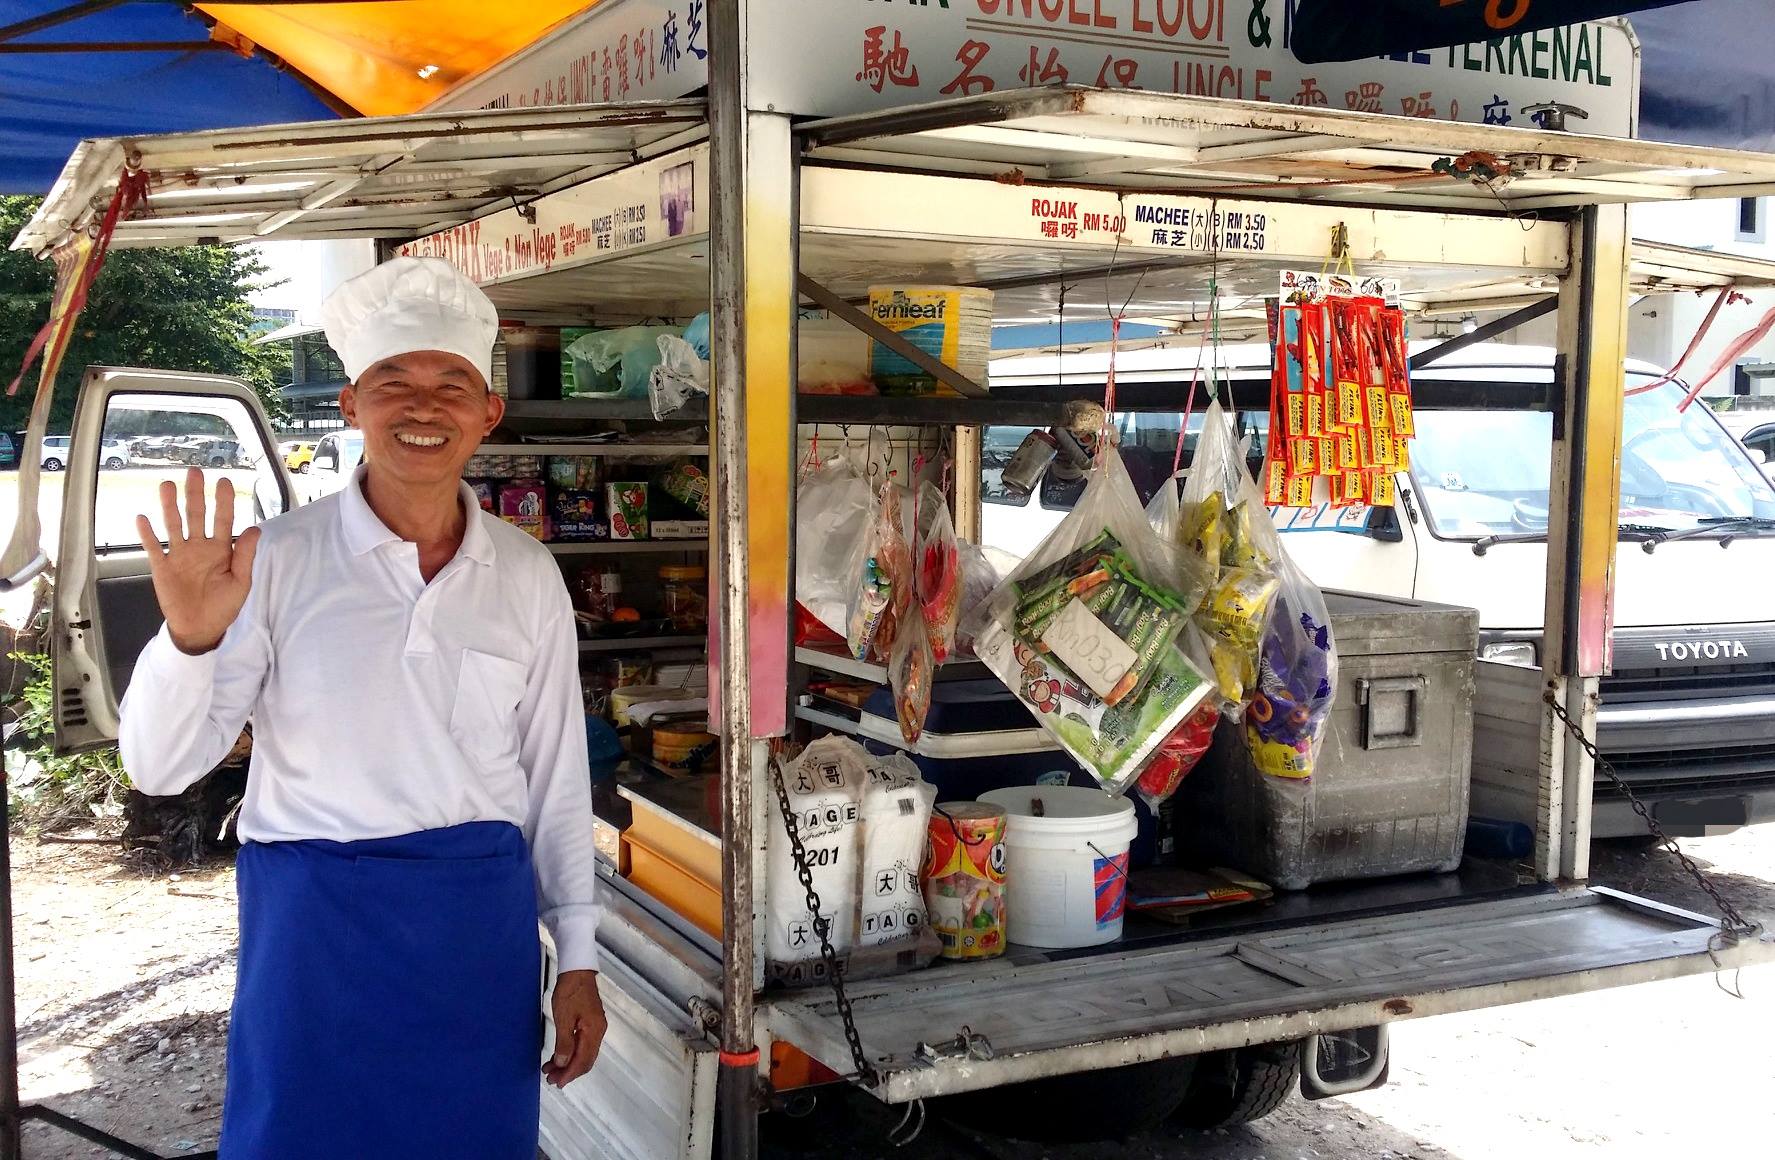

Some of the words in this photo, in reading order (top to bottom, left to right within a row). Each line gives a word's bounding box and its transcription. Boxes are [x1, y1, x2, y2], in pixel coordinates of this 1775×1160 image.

[1247, 0, 1272, 48] &
[1031, 198, 1078, 220] ROJAK
[1083, 212, 1101, 232] RM
[1102, 214, 1127, 234] 5.00
[1135, 204, 1190, 227] MACHEE
[1227, 212, 1243, 230] RM
[1245, 213, 1266, 232] 3.50
[514, 233, 532, 270] Non
[533, 226, 557, 272] Vege
[1151, 228, 1188, 248] 麻芝
[1225, 231, 1242, 250] RM
[1242, 232, 1266, 251] 2.50
[1655, 640, 1749, 661] TOYOTA
[809, 806, 857, 828] AGE
[865, 911, 918, 931] TAG
